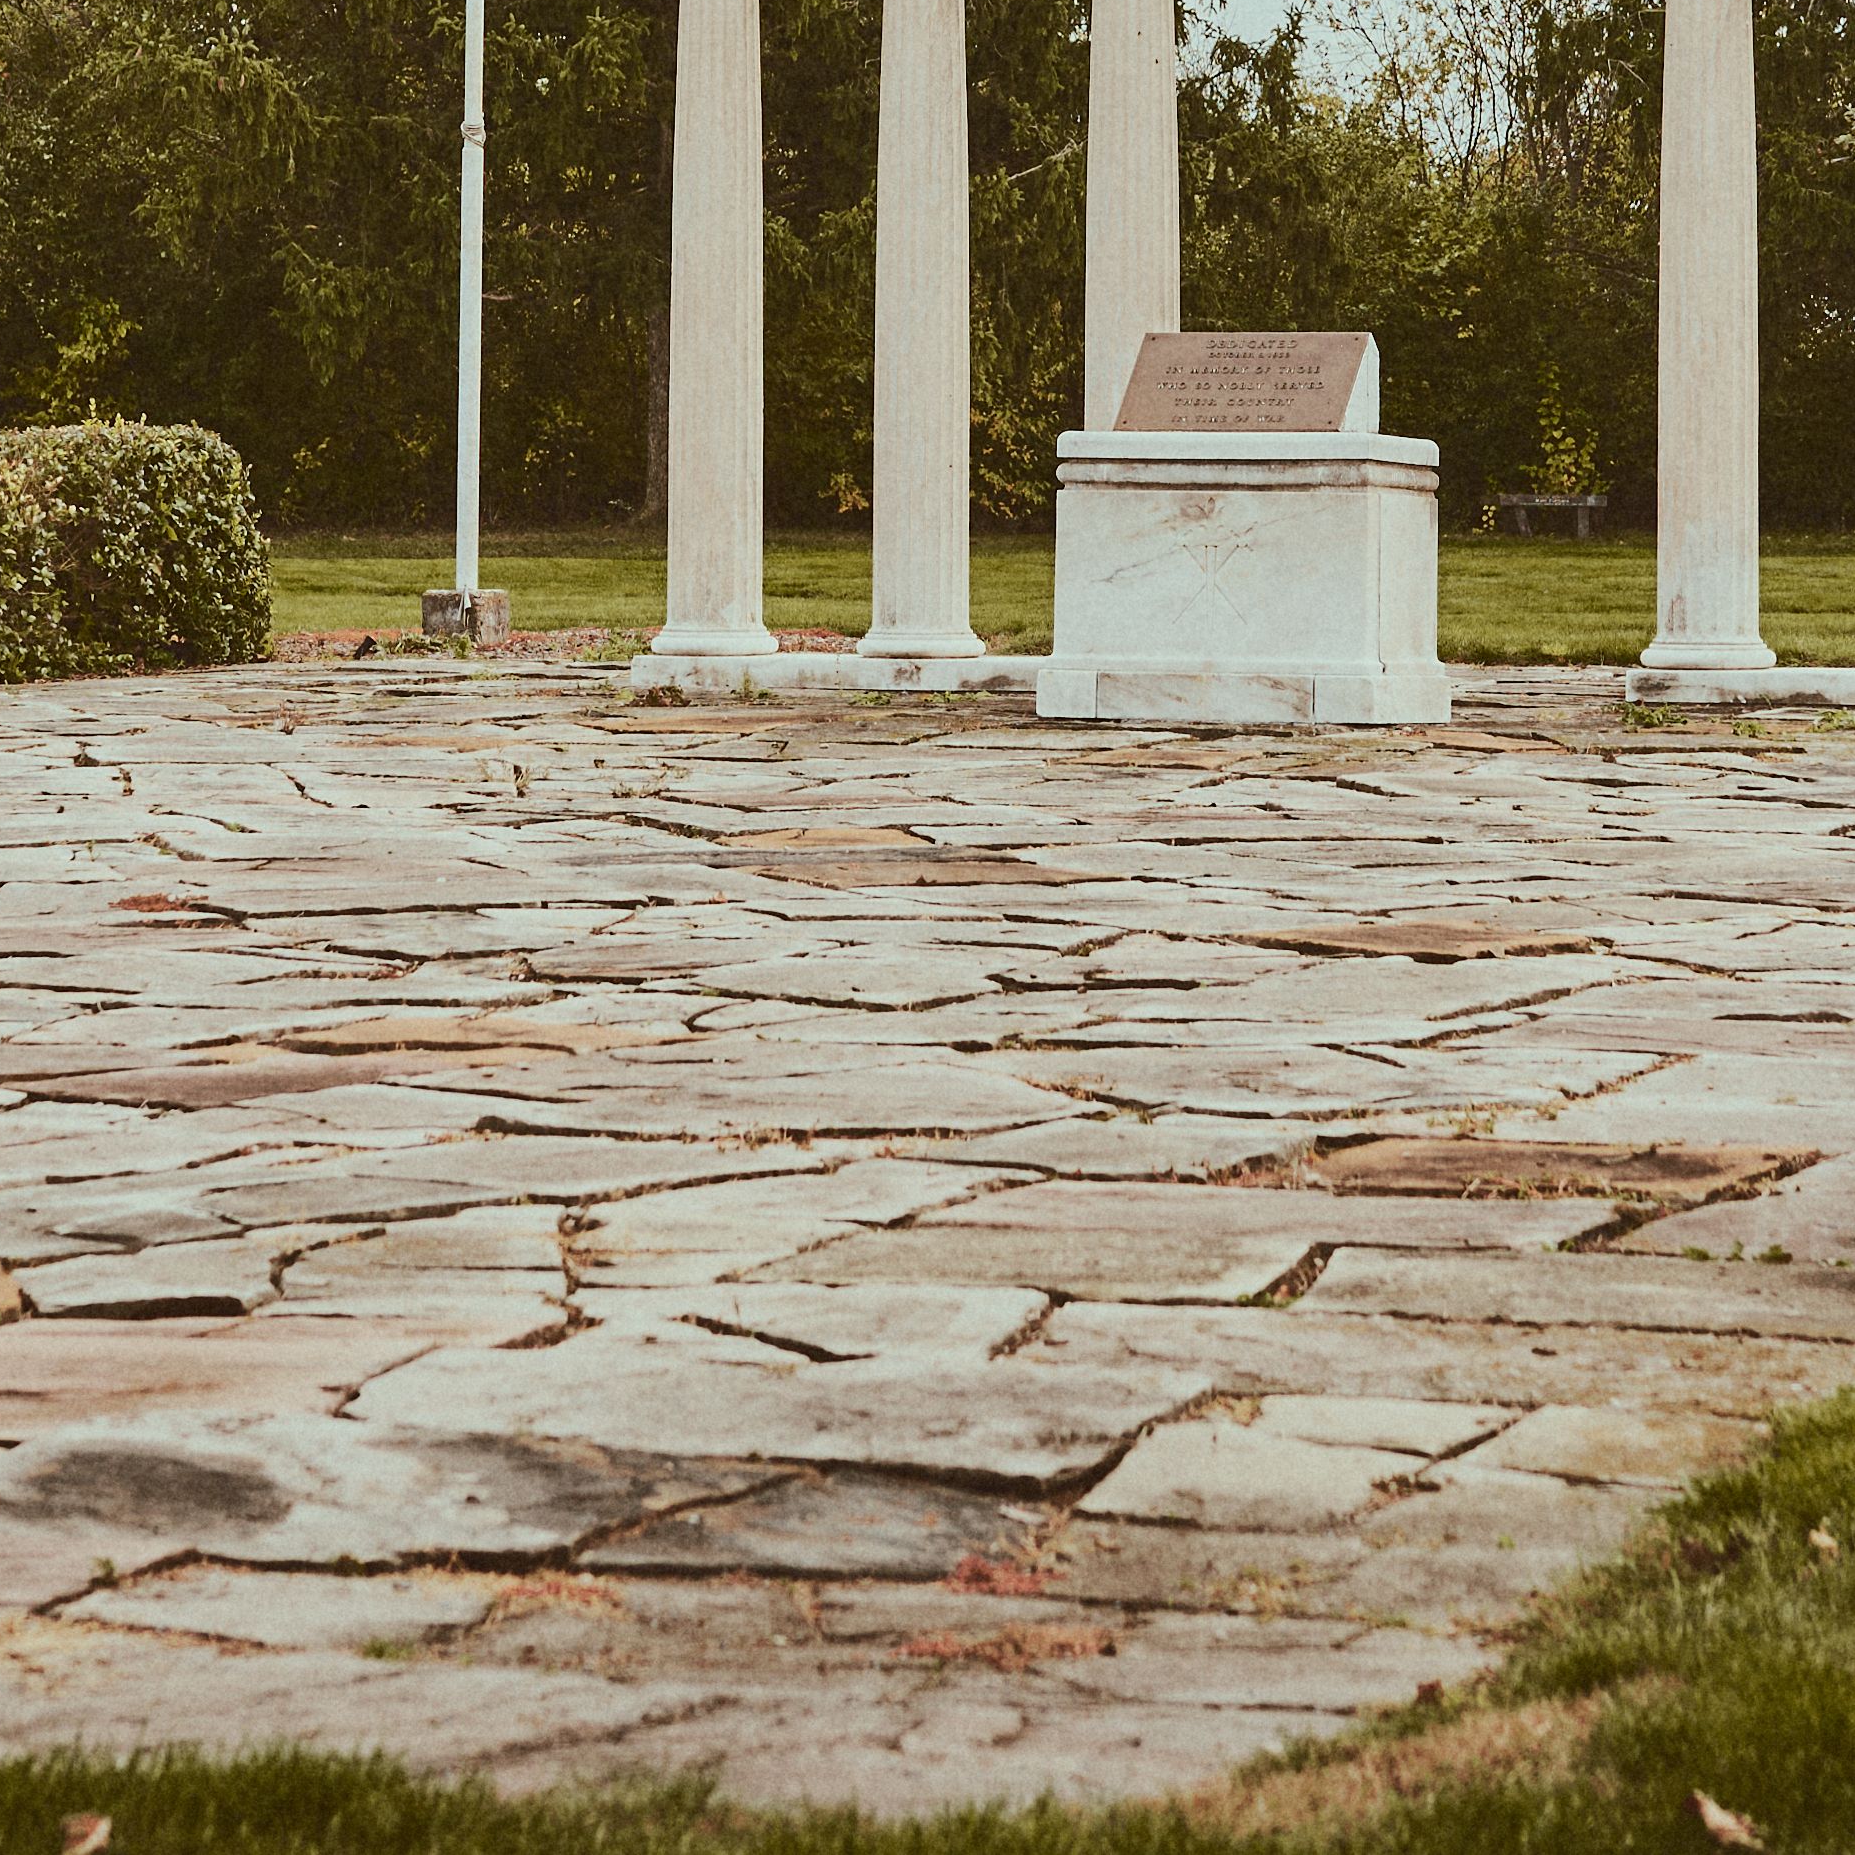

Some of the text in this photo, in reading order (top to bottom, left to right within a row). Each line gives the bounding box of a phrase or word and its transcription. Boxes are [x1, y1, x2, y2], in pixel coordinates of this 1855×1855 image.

[1206, 339, 1299, 349] DEDICATED
[1165, 366, 1321, 374] IN MEMORY OF THOSE
[1157, 381, 1325, 390] WHO SO NOBLY SERVED
[1175, 398, 1294, 406] THEIR COUNTRY
[1171, 415, 1286, 423] IN TIME OF WAR
